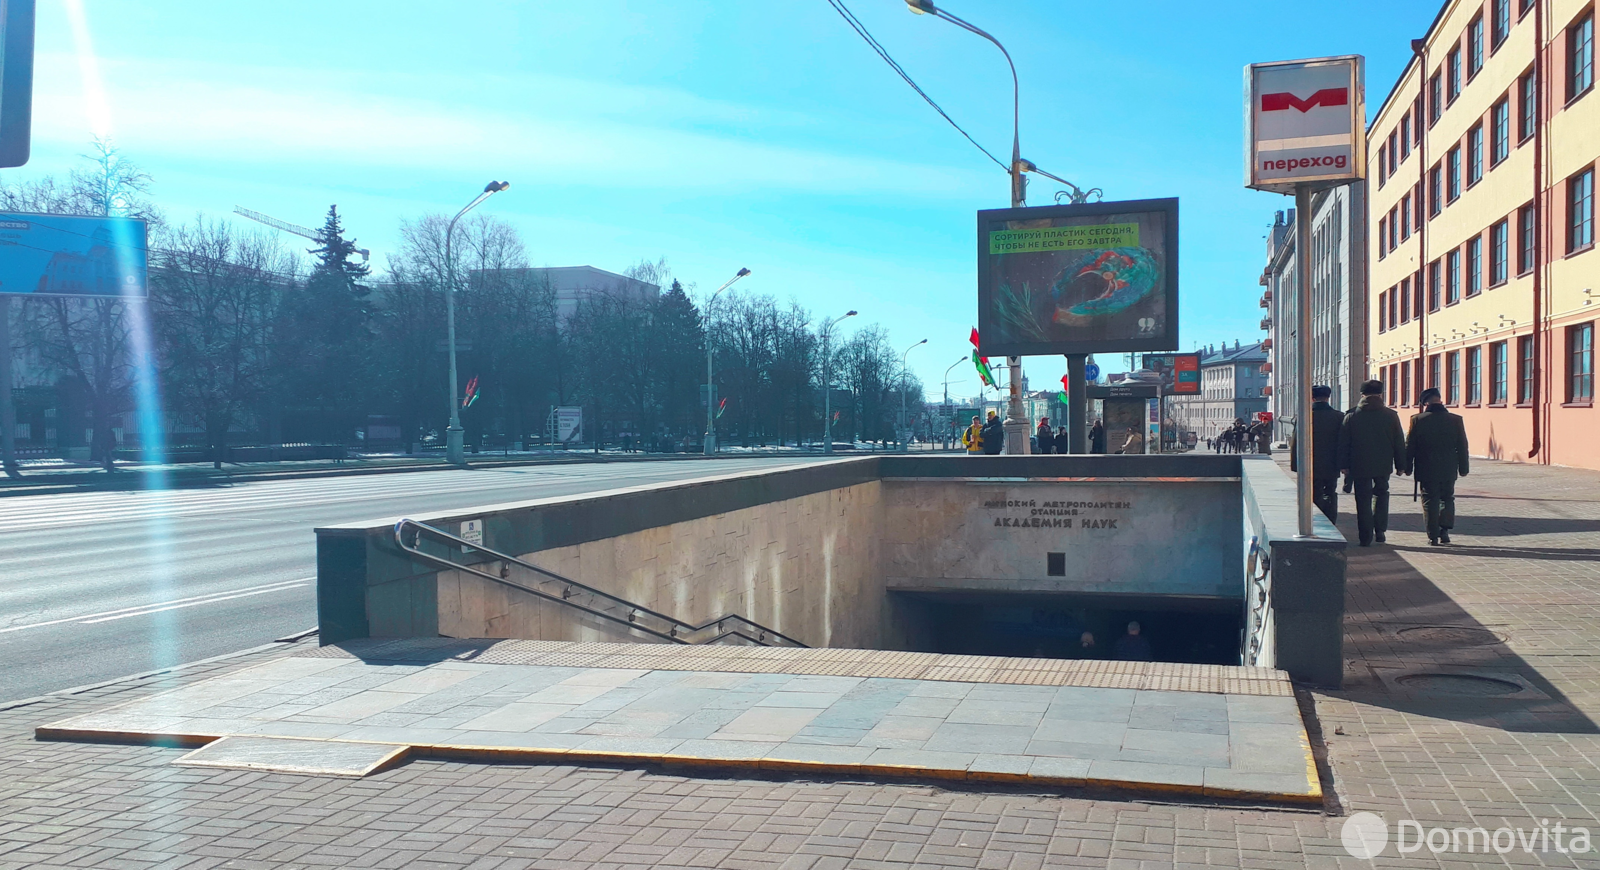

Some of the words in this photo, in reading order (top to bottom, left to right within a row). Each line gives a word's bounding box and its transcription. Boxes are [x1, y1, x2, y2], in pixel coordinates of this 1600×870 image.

[1263, 154, 1347, 172] переход
[994, 230, 1042, 241] СОРТИРУЙ
[1044, 229, 1086, 238] ПЛАСТИК
[1089, 226, 1134, 236] СЕГОДНЯ,
[994, 242, 1026, 250] ЧТОБЫ
[1028, 241, 1040, 249] НЕ
[1042, 240, 1065, 248] ЕСТЬ
[1067, 238, 1084, 246] ЕГО
[1087, 236, 1122, 246] ЗАВТРА
[1043, 500, 1131, 509] МЕТРОПОЛИТЕН
[1030, 508, 1078, 516] СТАНЦИЯ
[994, 517, 1072, 529] АКАДЕМИЯ
[1081, 519, 1118, 529] НАУК
